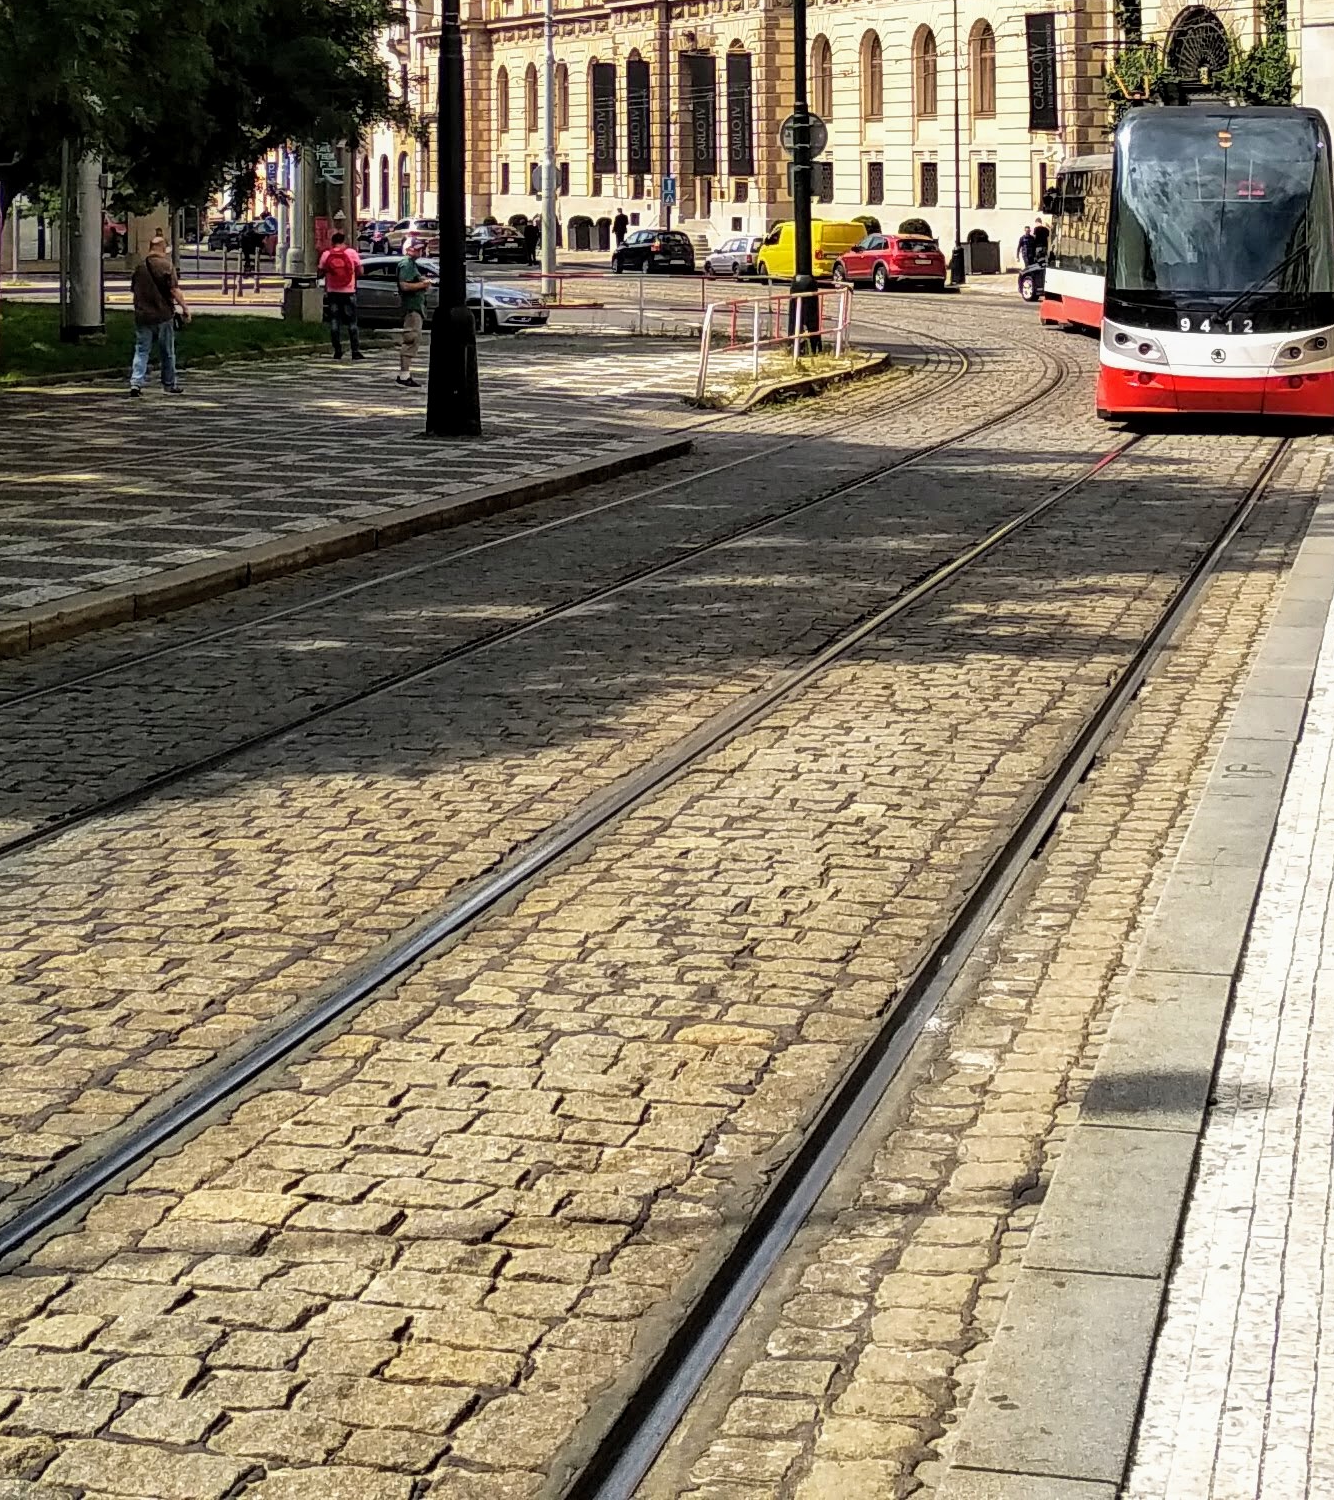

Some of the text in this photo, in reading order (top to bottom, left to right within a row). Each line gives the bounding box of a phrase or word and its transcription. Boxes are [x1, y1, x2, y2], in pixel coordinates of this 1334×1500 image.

[596, 122, 607, 159] CARLO
[631, 122, 641, 159] CARLO
[696, 121, 706, 160] CARLO
[731, 120, 742, 160] CARLO
